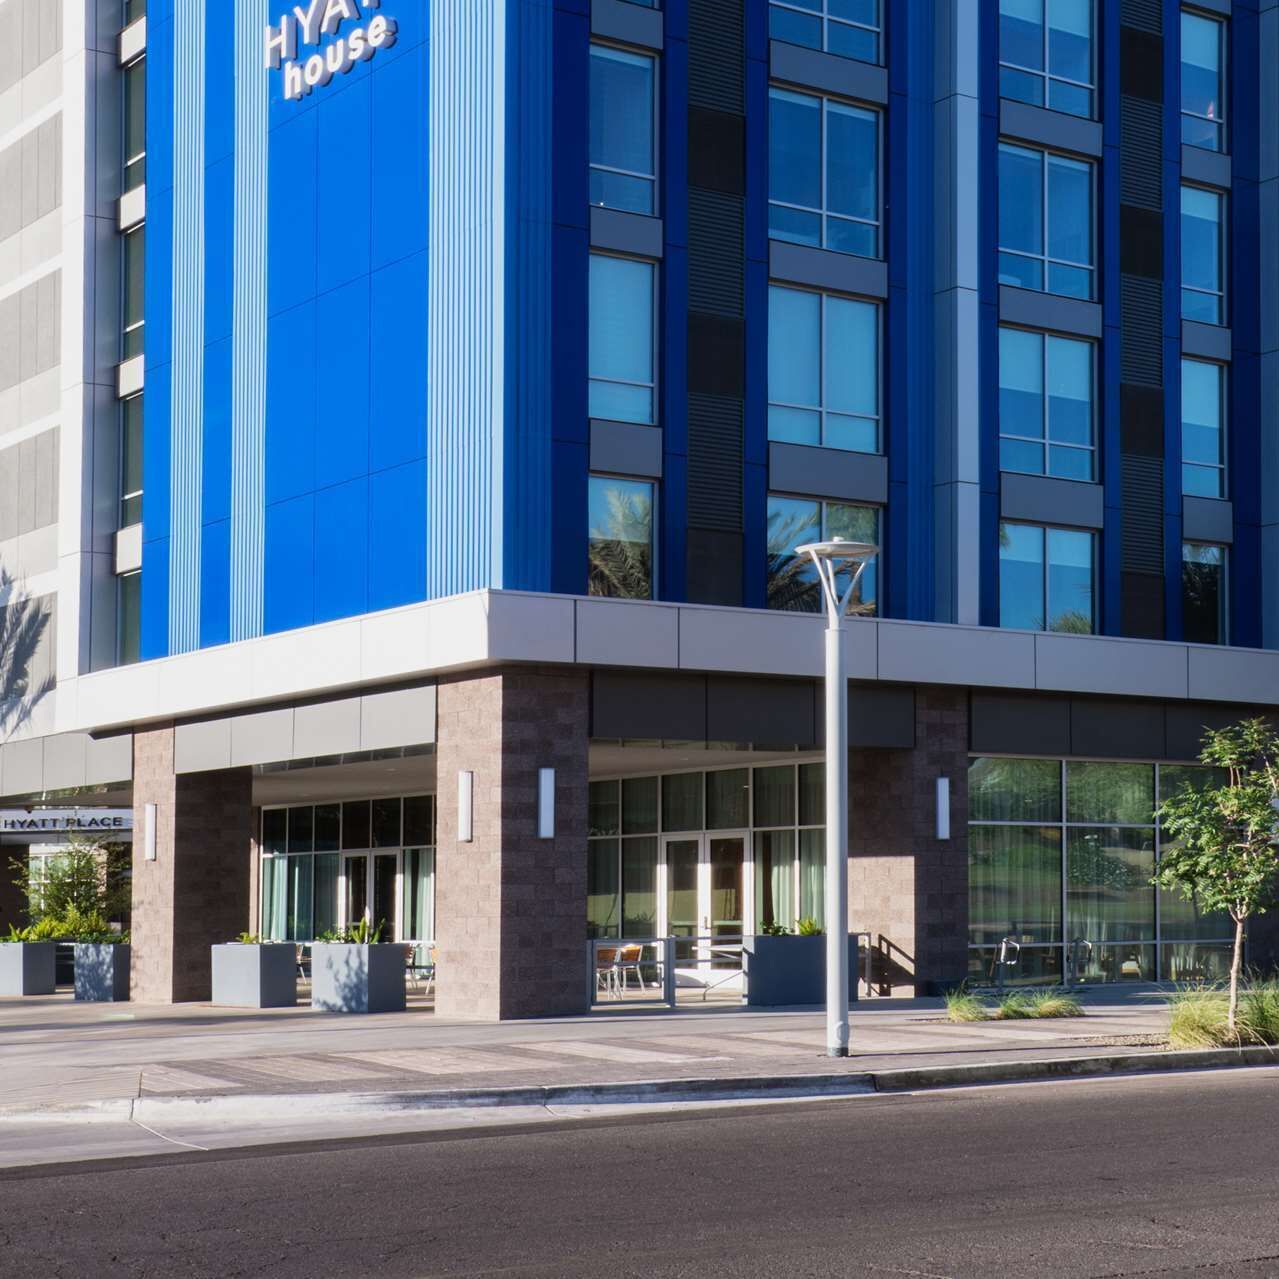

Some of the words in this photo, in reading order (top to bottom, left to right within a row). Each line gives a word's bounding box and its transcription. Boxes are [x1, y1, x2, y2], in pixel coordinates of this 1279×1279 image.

[285, 15, 395, 100] house
[4, 818, 61, 829] HYATT
[65, 816, 123, 828] PLACE
